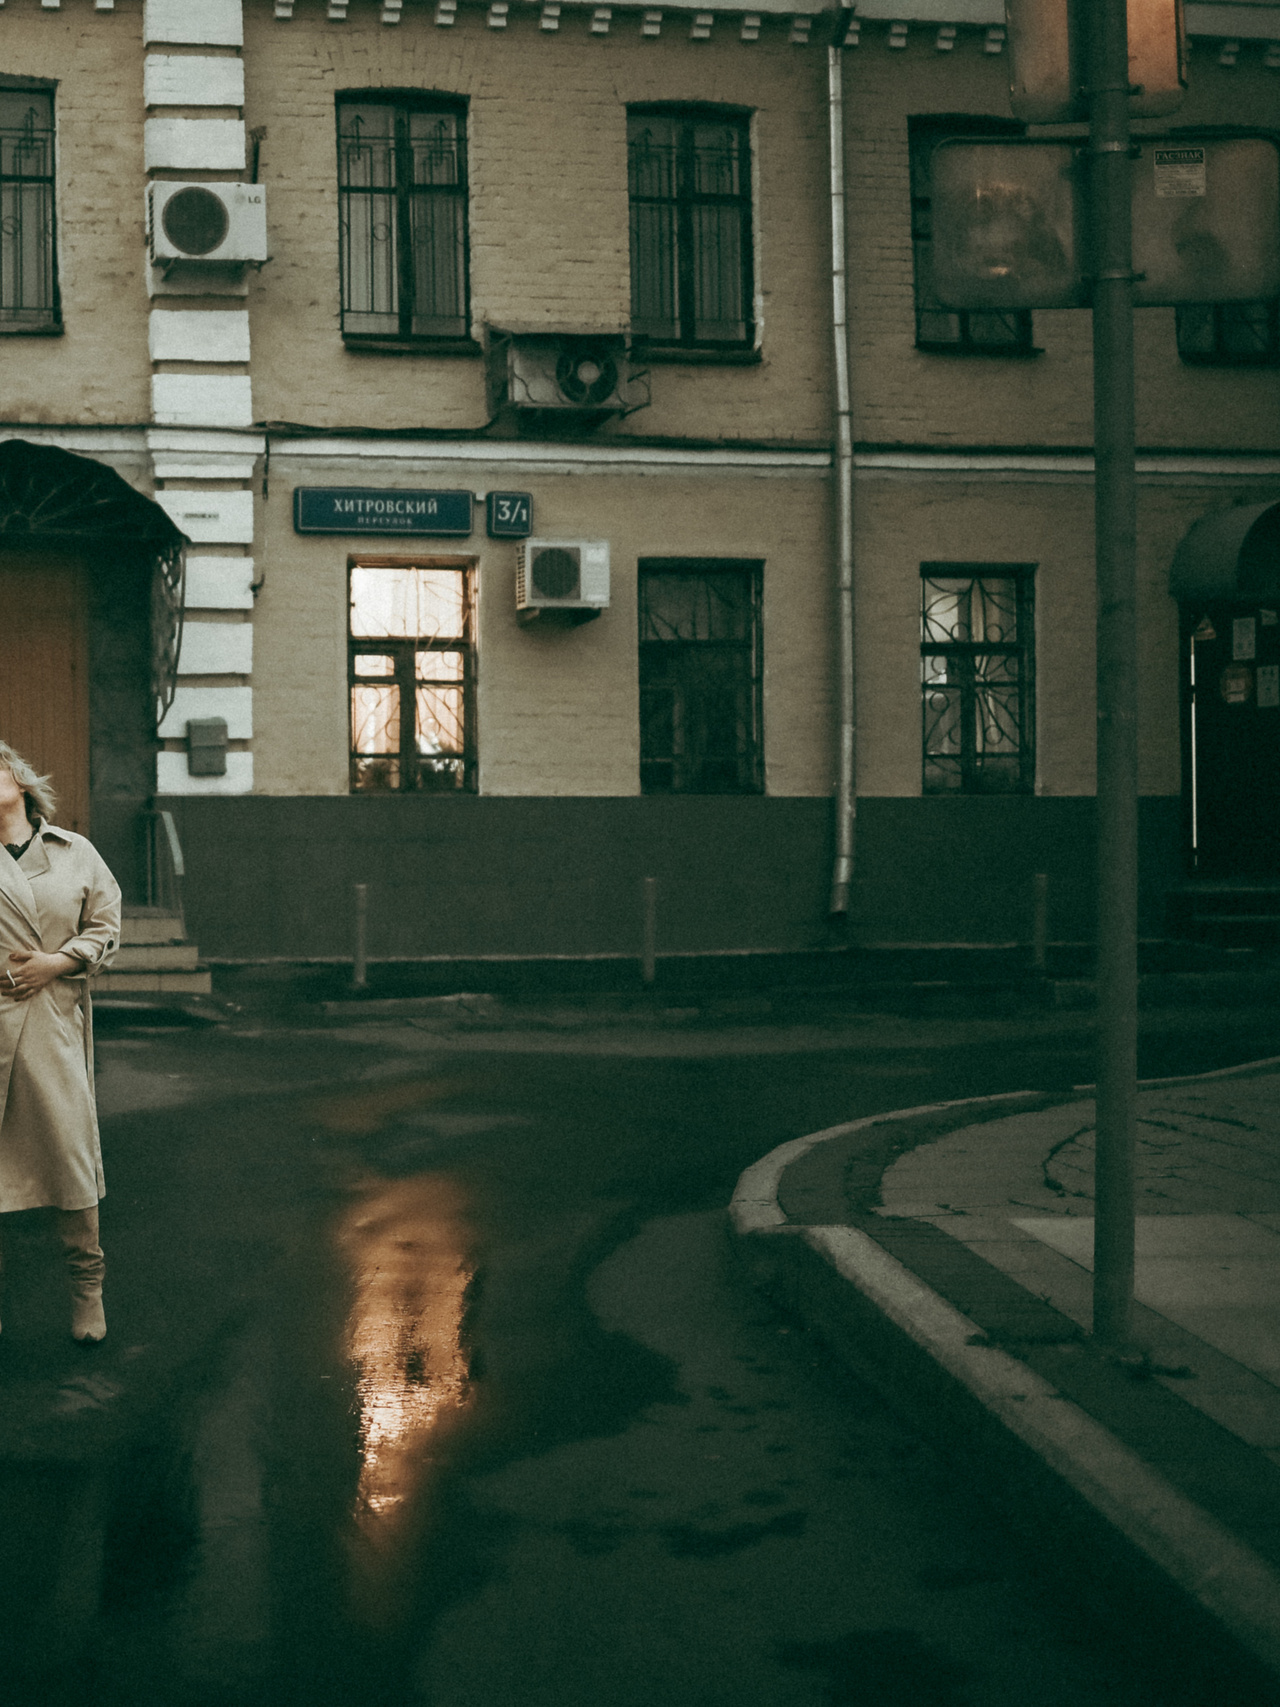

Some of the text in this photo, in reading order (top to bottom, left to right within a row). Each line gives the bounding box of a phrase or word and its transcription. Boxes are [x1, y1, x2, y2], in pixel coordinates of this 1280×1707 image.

[248, 195, 261, 204] LG
[334, 498, 438, 514] ХИТРОВСКИЙ
[498, 500, 527, 523] 3/1
